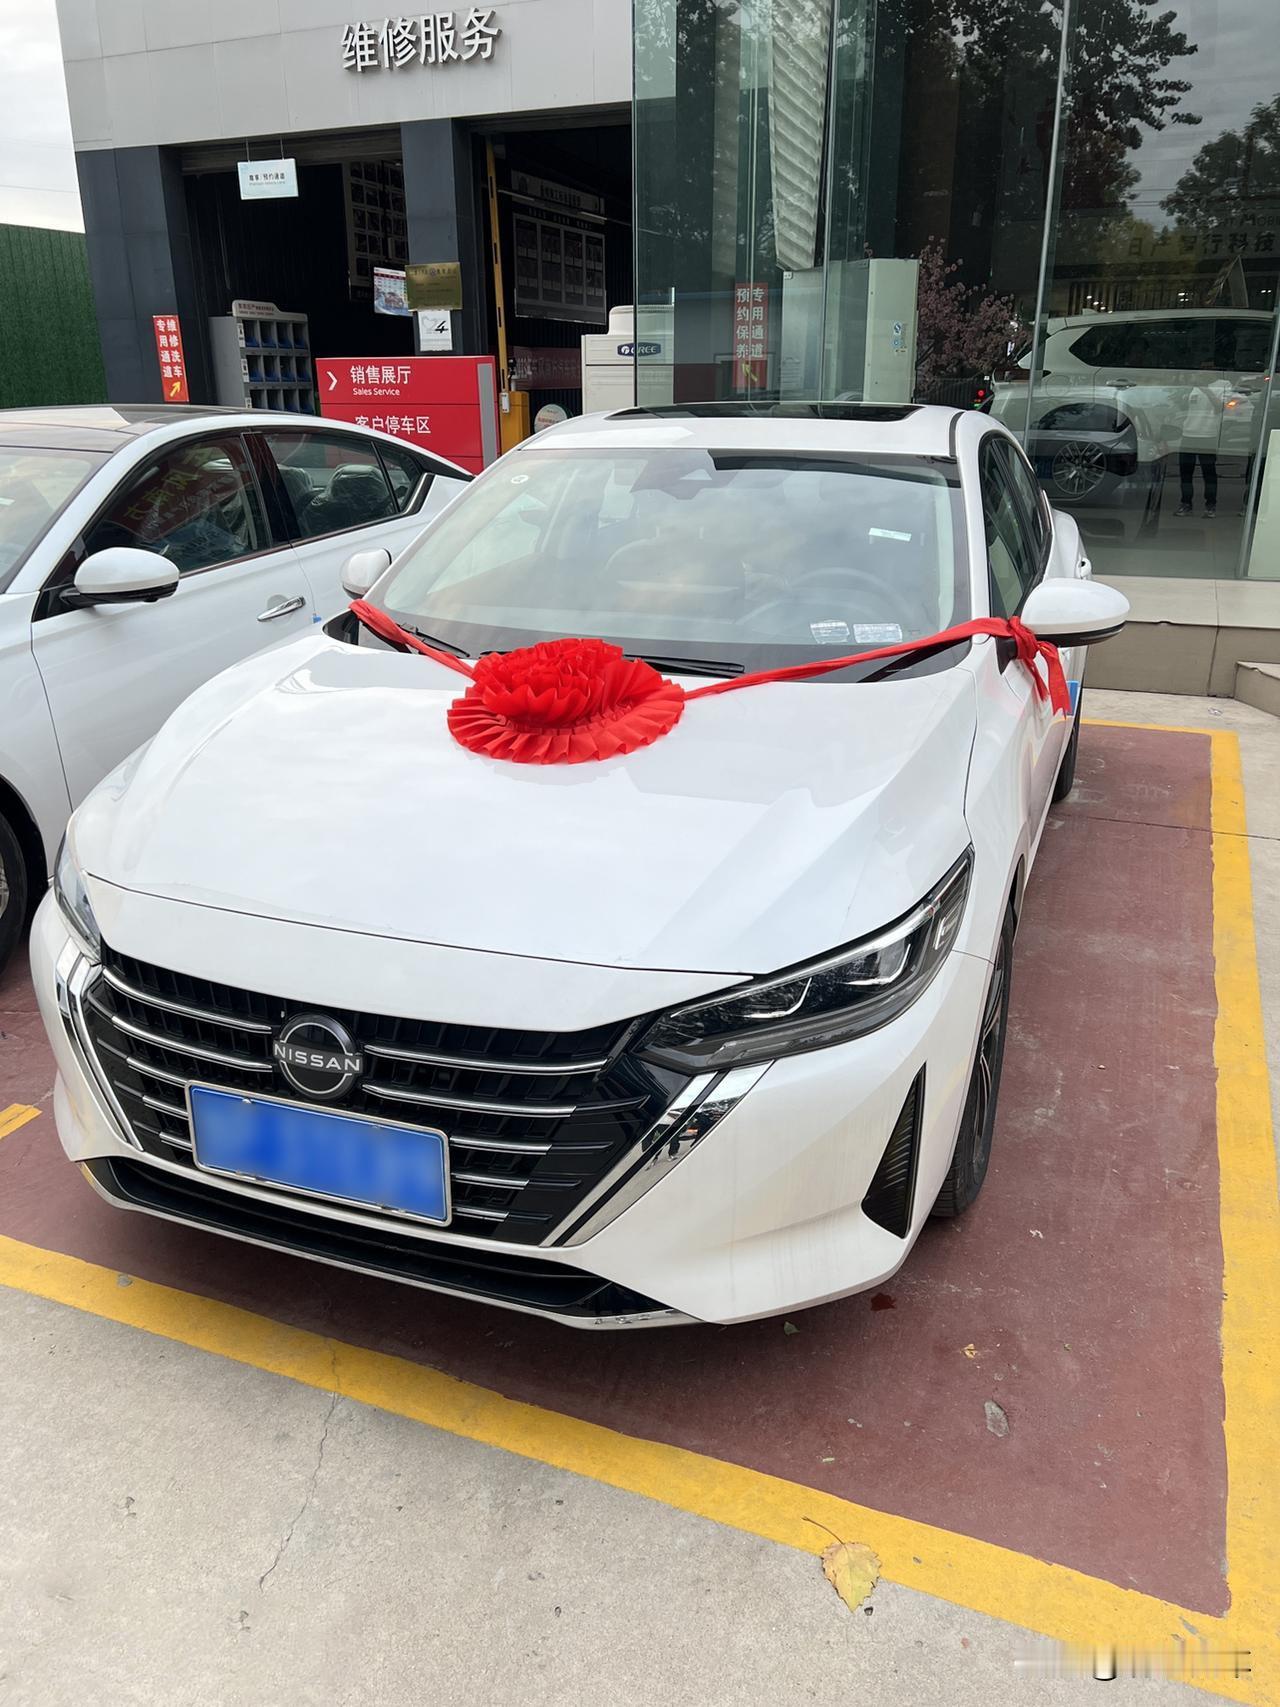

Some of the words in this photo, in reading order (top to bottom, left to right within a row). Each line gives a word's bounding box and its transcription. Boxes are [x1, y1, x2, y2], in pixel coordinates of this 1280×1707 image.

[341, 7, 501, 72] 维修服务
[156, 319, 173, 378] 专用通道
[166, 319, 183, 377] 维修洗车
[736, 288, 750, 358] 预约保养
[751, 288, 764, 358] 专用通道
[350, 365, 411, 385] 销售展厅
[353, 388, 372, 396] Sales
[373, 388, 400, 396] Service
[355, 415, 431, 434] 客户停车区
[274, 1043, 360, 1071] NISSAN
